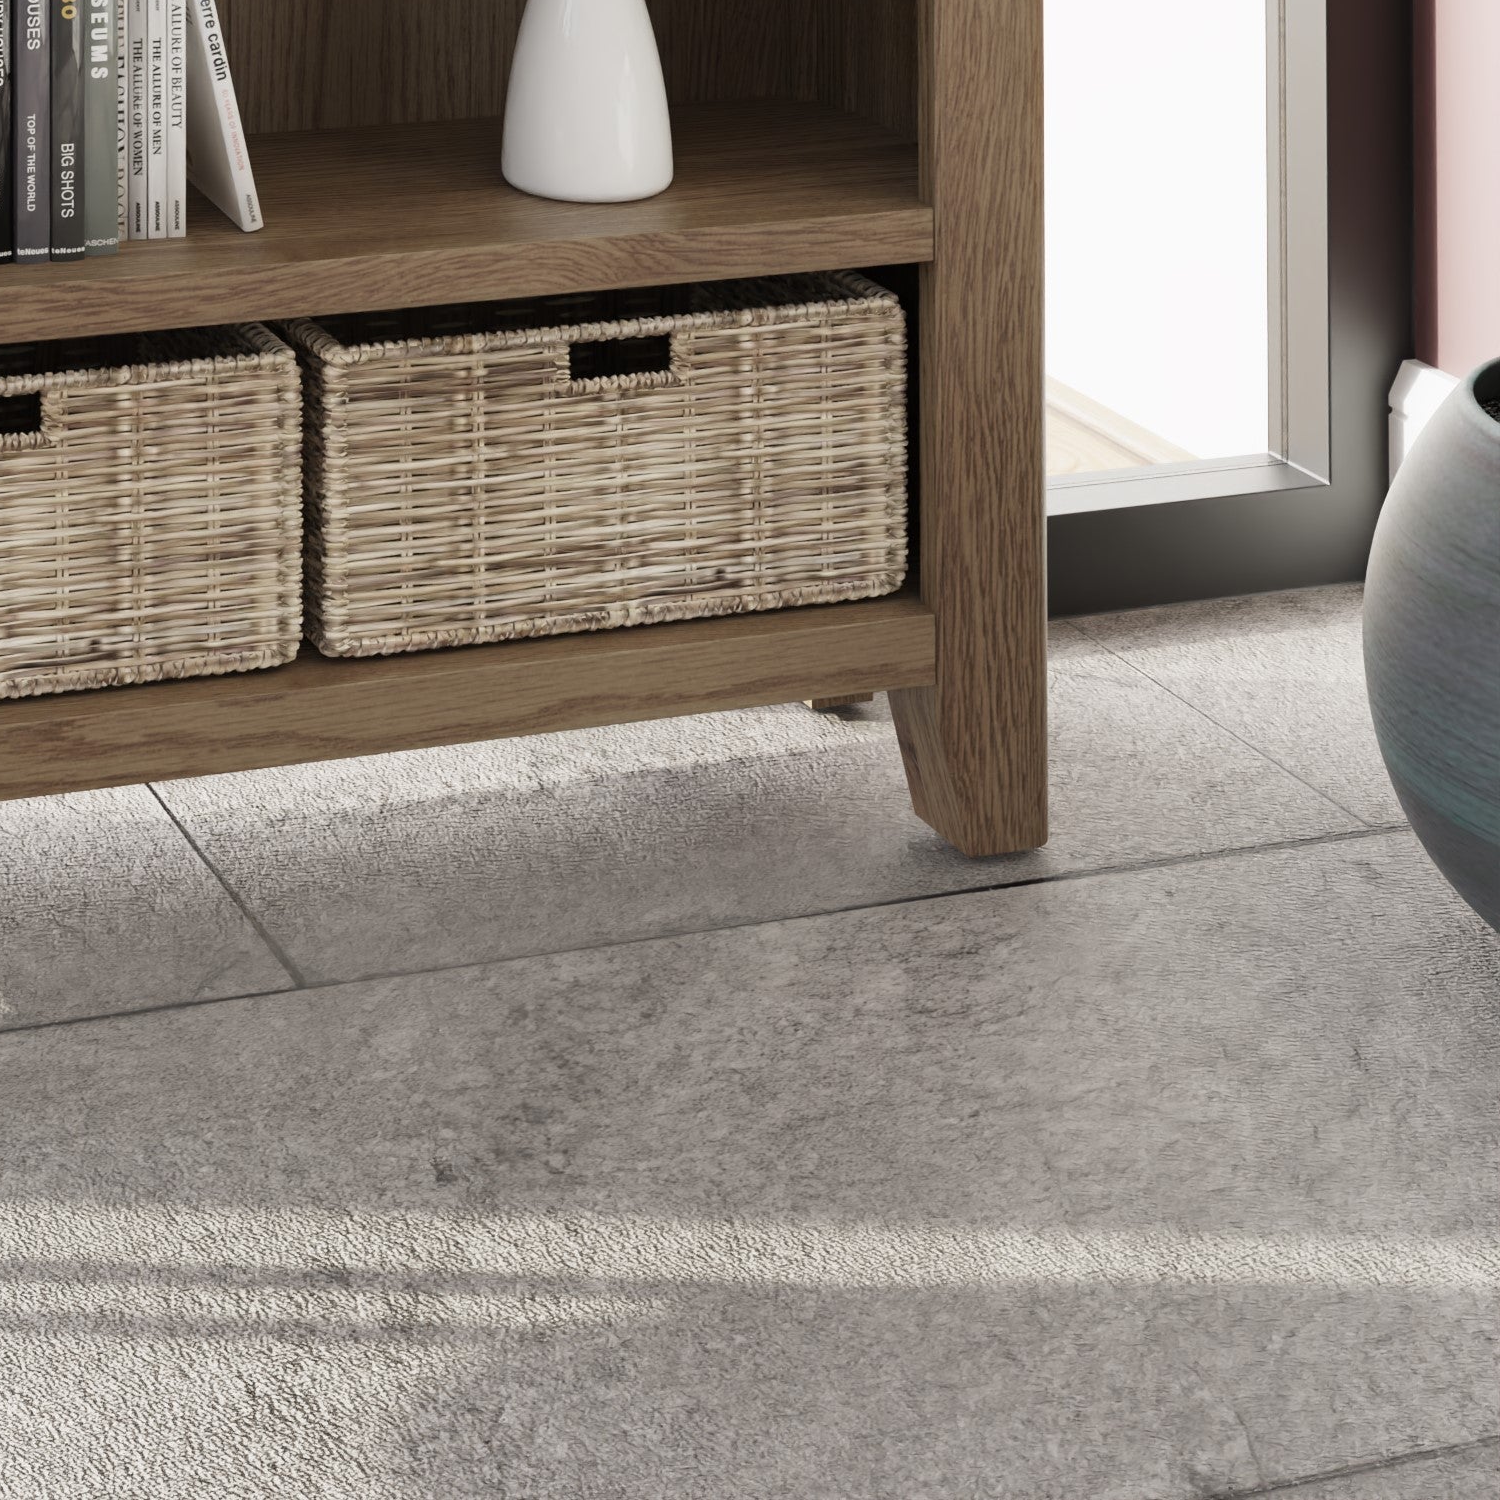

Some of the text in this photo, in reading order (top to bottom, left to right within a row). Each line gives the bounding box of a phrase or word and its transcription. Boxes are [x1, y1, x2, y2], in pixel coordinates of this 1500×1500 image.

[172, 4, 182, 54] ALLURE
[208, 33, 227, 81] cardin
[152, 37, 161, 155] THE ALLURE OF MEN
[172, 55, 182, 75] OF
[133, 38, 143, 176] THE ALLURE OF WOMEN
[172, 77, 182, 129] BEAUTY
[27, 114, 35, 212] TOP OF THE WORLD
[61, 143, 74, 218] BIG SHOTS
